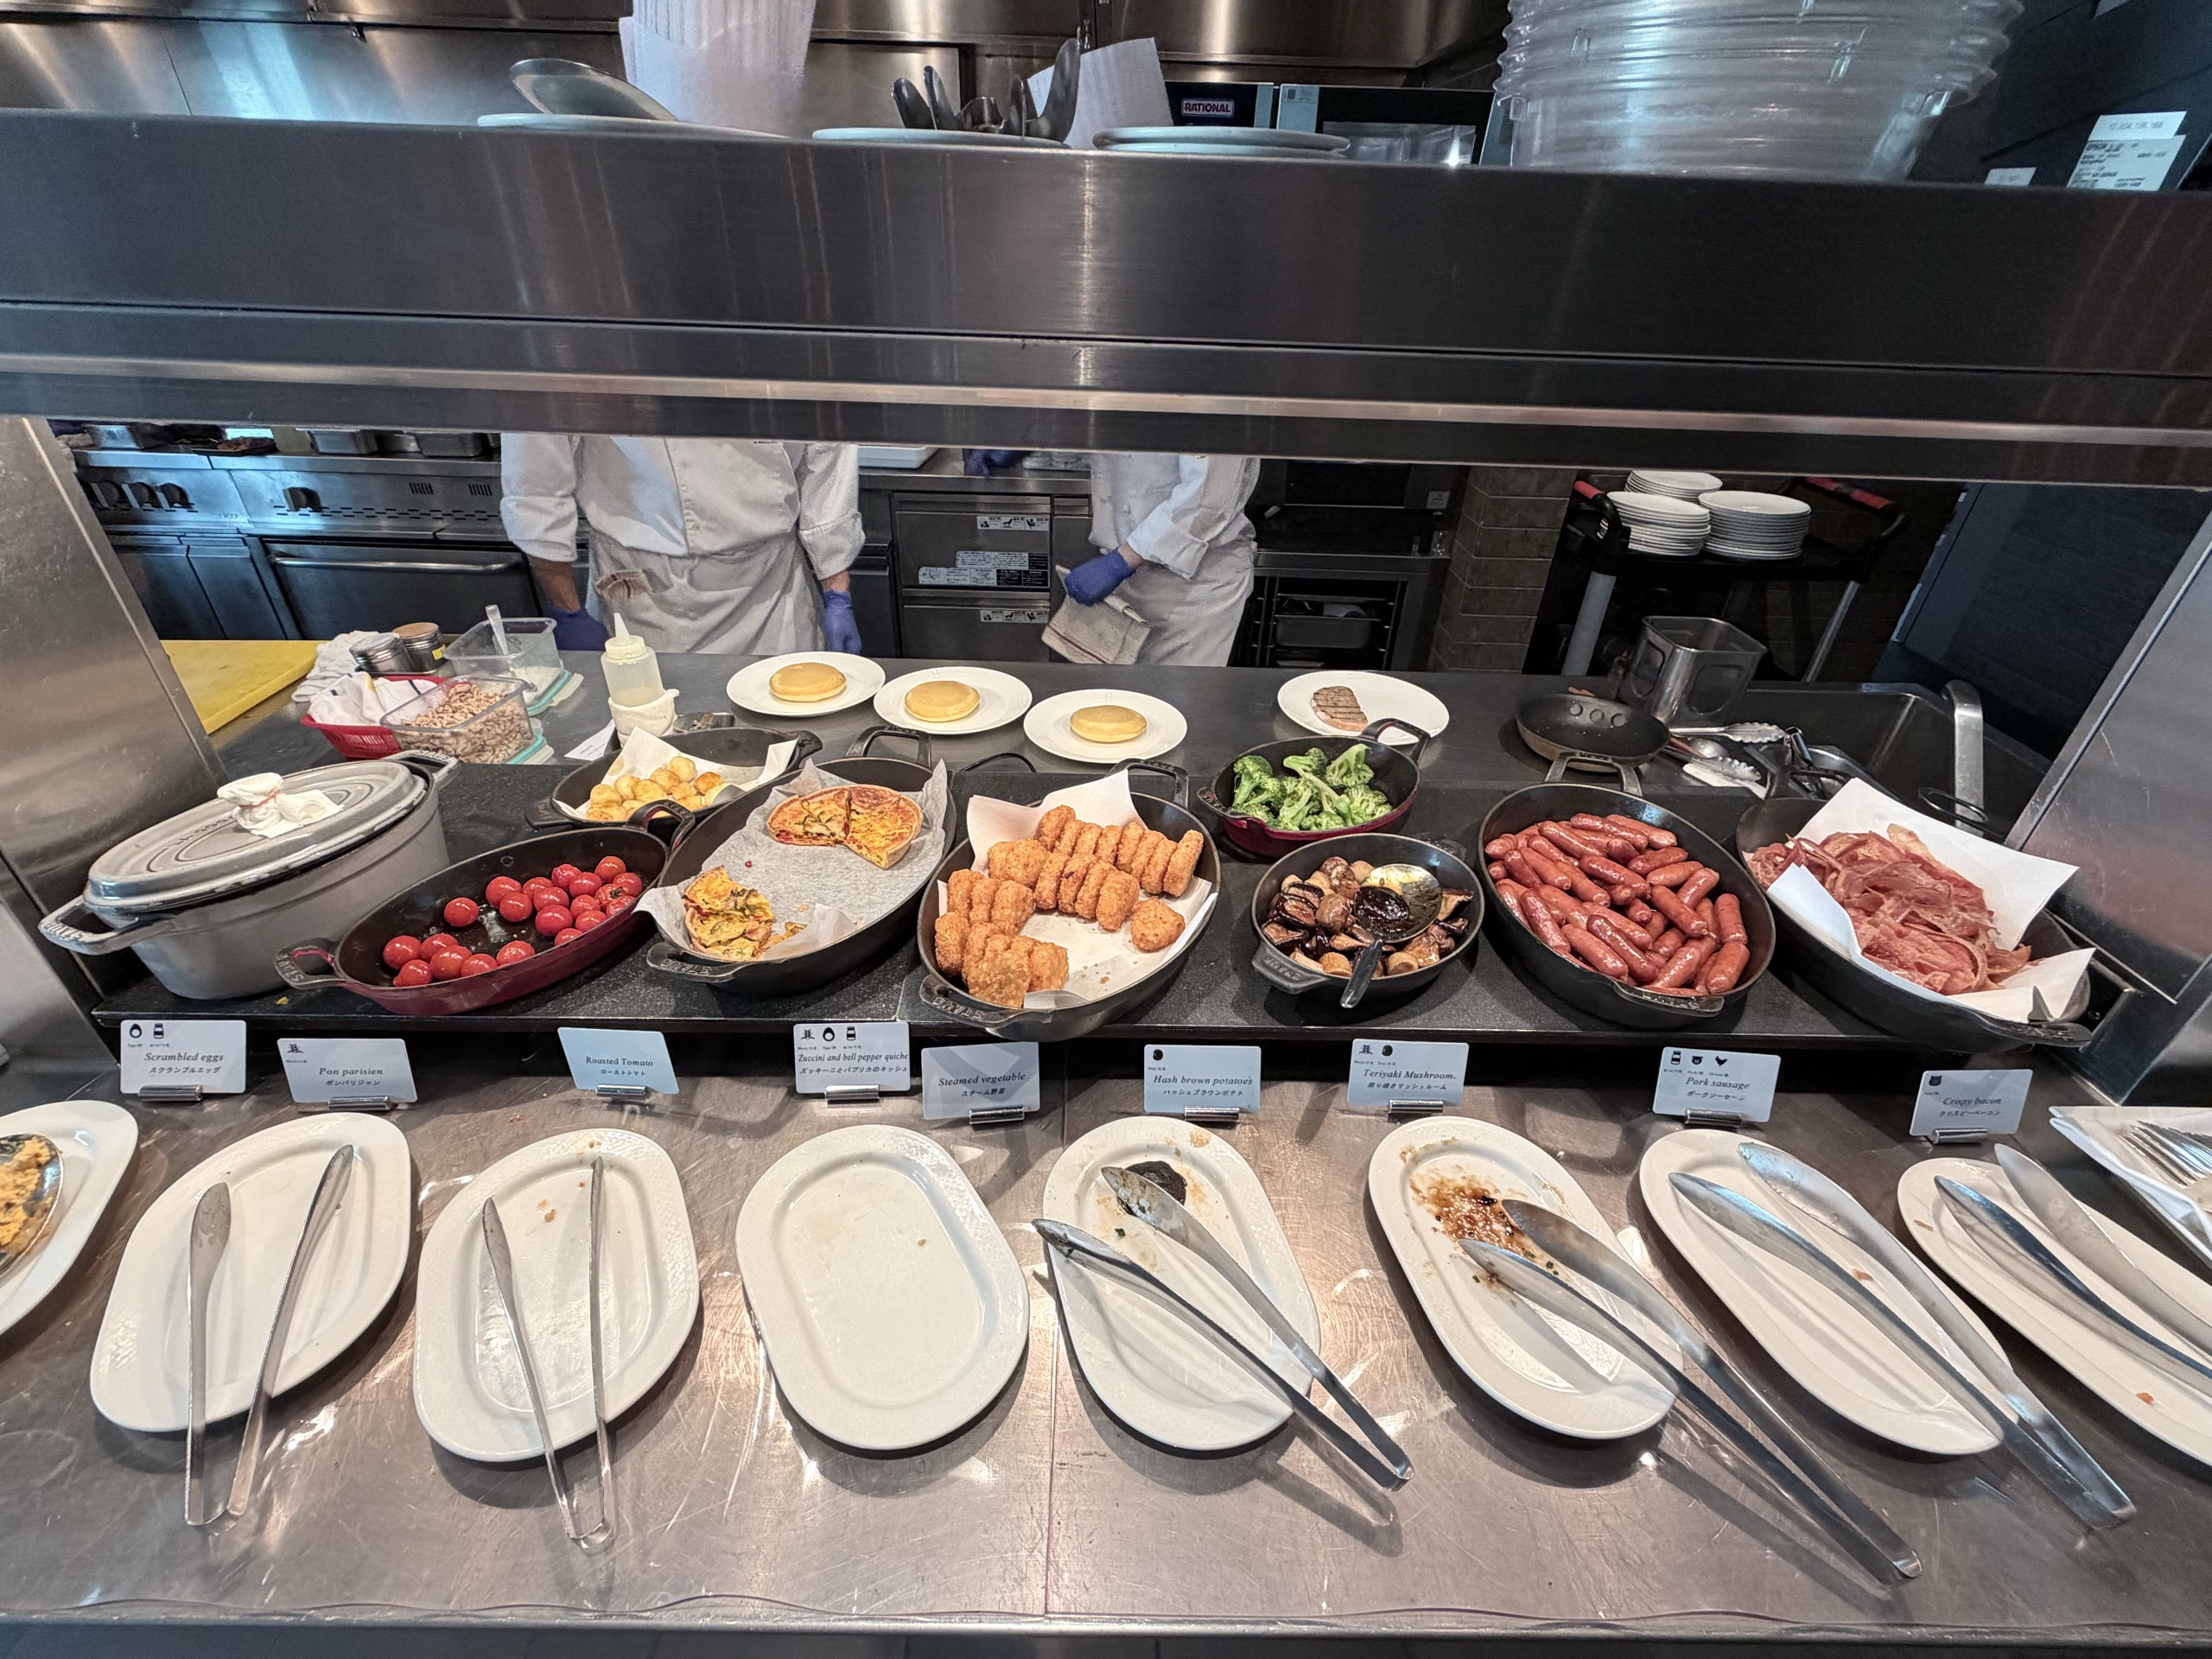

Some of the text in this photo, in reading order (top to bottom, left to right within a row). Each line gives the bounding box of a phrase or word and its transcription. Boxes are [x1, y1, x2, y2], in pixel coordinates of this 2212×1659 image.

[1185, 103, 1230, 112] RATIONAL
[660, 958, 712, 976] STAUB
[932, 996, 986, 1020] STAUB
[143, 1052, 224, 1063] Scrambled eggs
[586, 1056, 653, 1066] Roasted Tomato
[798, 1052, 908, 1063] Zuccini and bell pepper quiche
[319, 1067, 383, 1077] Pon parisien
[1363, 1069, 1402, 1079] Teriyaki
[938, 1072, 1027, 1086] Steamed vegetable
[1154, 1075, 1253, 1086] Hash brown potatoes
[1686, 1077, 1750, 1090] Pork sausage
[1162, 1088, 1243, 1096] ハッシュブラウンポテト
[1942, 1096, 2002, 1107] Crispy bacon
